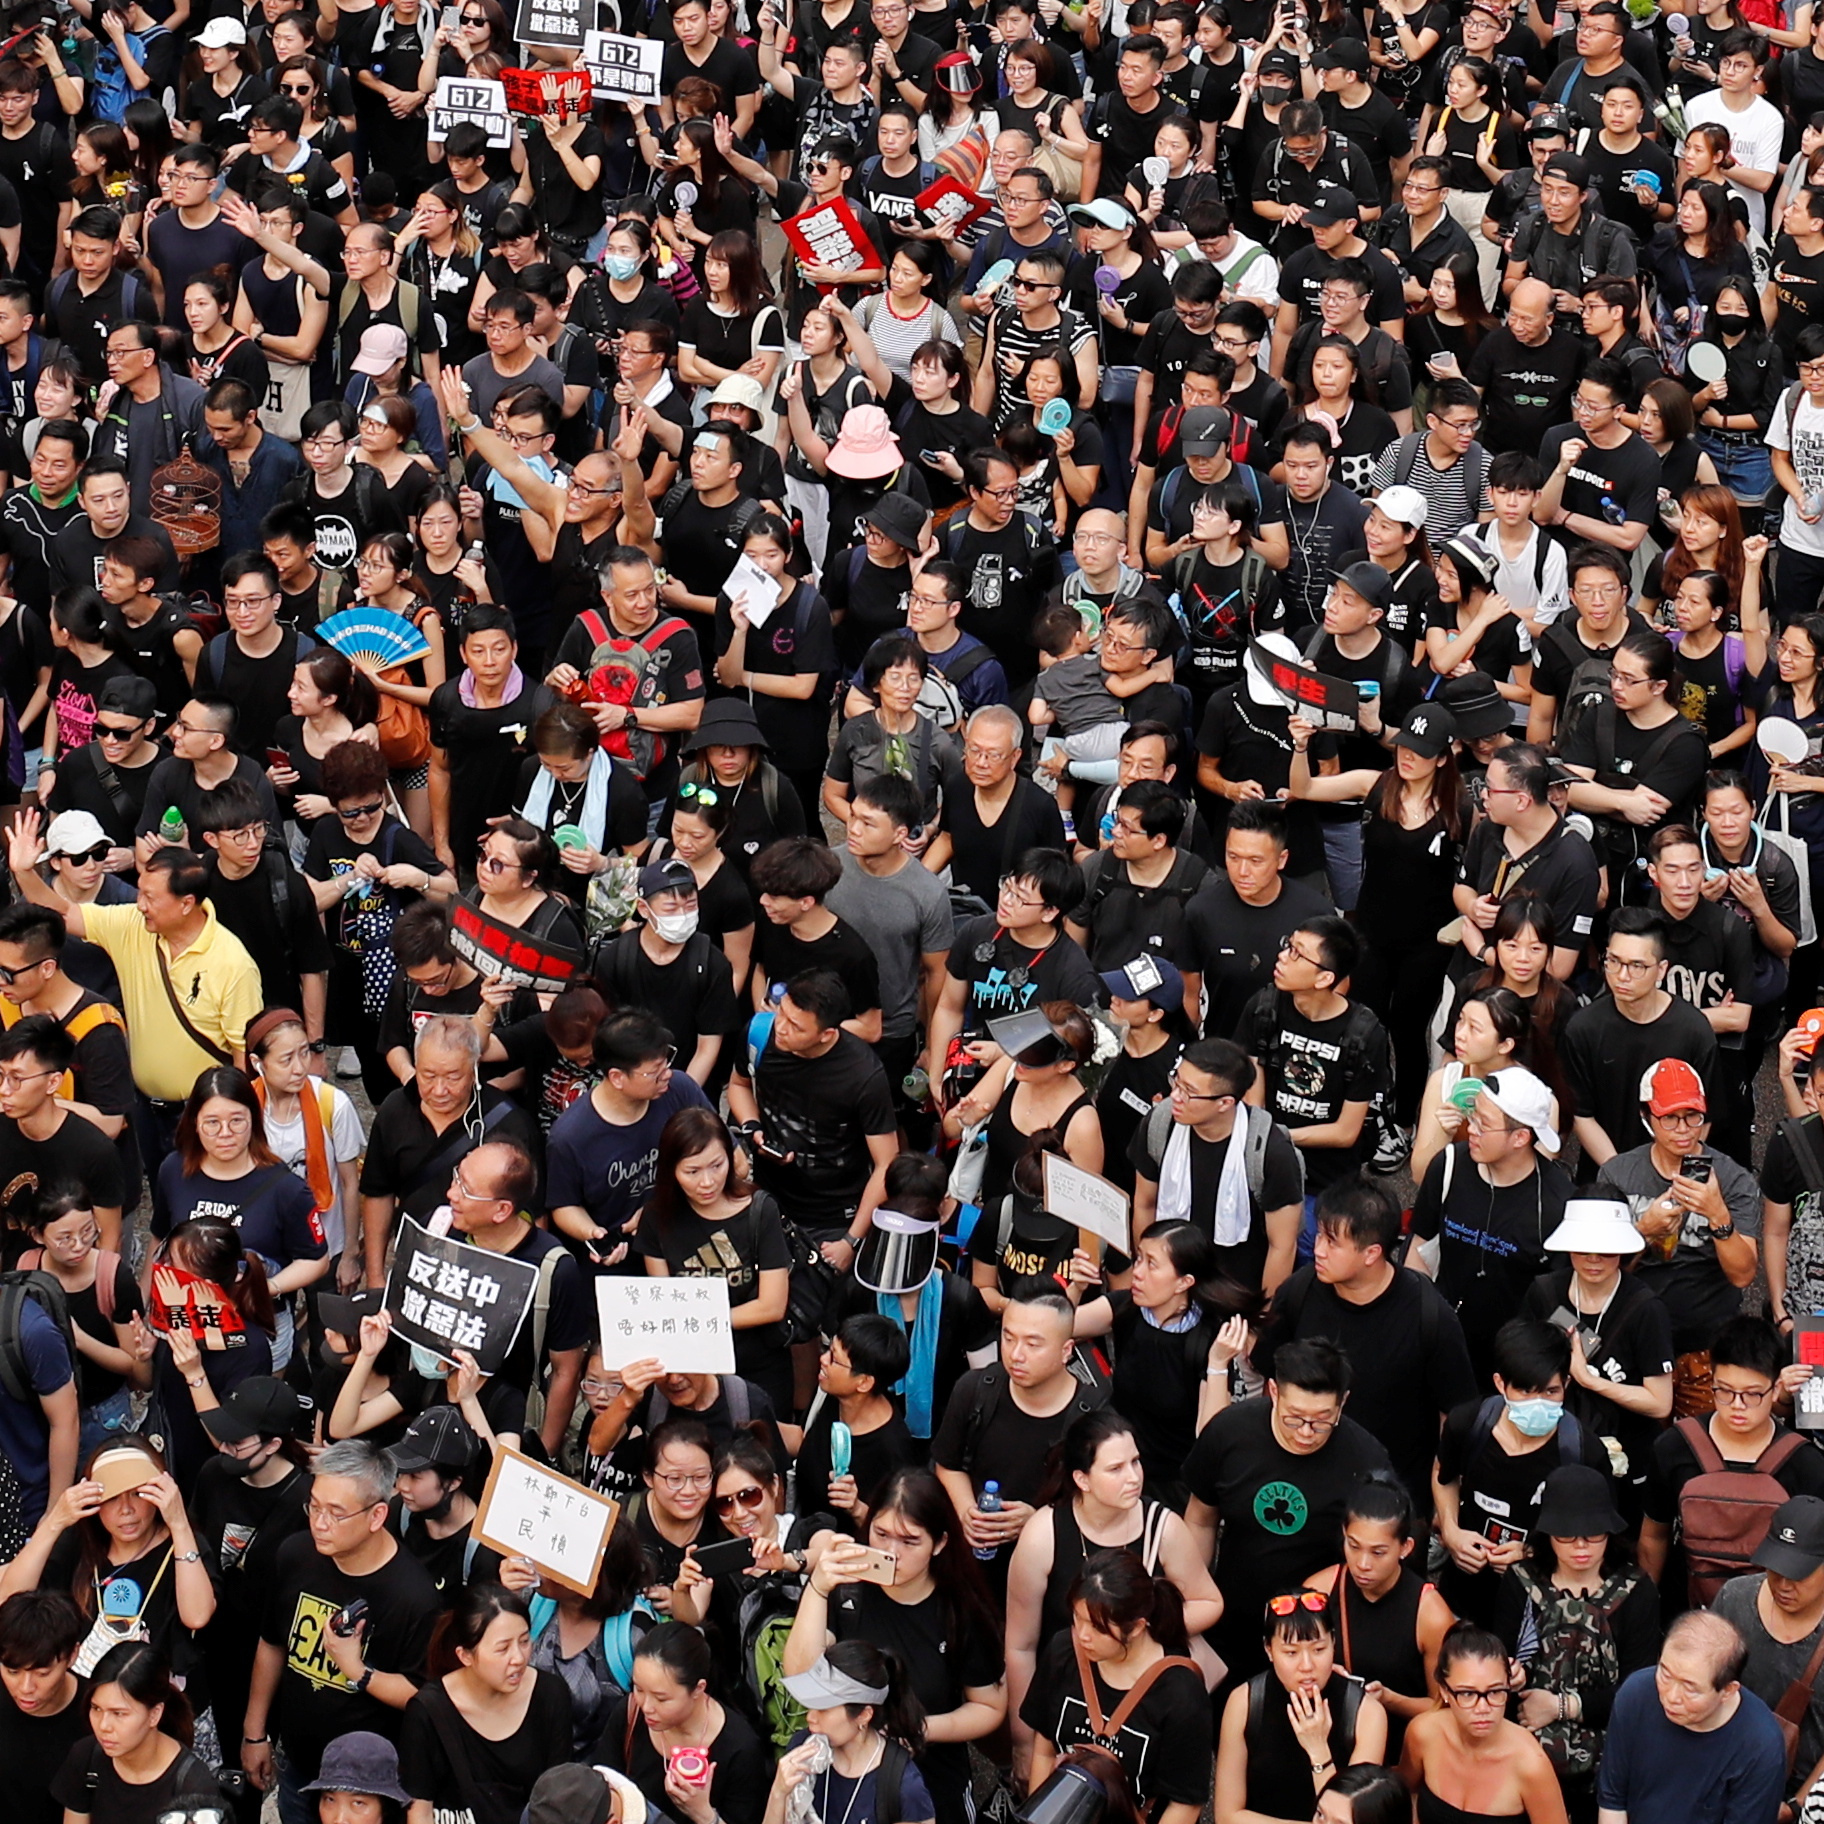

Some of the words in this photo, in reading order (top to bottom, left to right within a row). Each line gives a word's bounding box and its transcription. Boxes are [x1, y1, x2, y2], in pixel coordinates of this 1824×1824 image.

[602, 42, 639, 67] 612
[590, 65, 653, 93] 不是暴動
[450, 87, 491, 109] 612
[869, 192, 916, 219] VANS
[316, 533, 350, 546] ATMAN
[1272, 663, 1327, 705] 學生
[1281, 1030, 1340, 1062] PEPSI
[407, 1250, 501, 1308] 反送中
[623, 1285, 711, 1305] 警察叔叔
[523, 1475, 590, 1520] 林鄭下台
[1258, 1484, 1306, 1514] CELTICS
